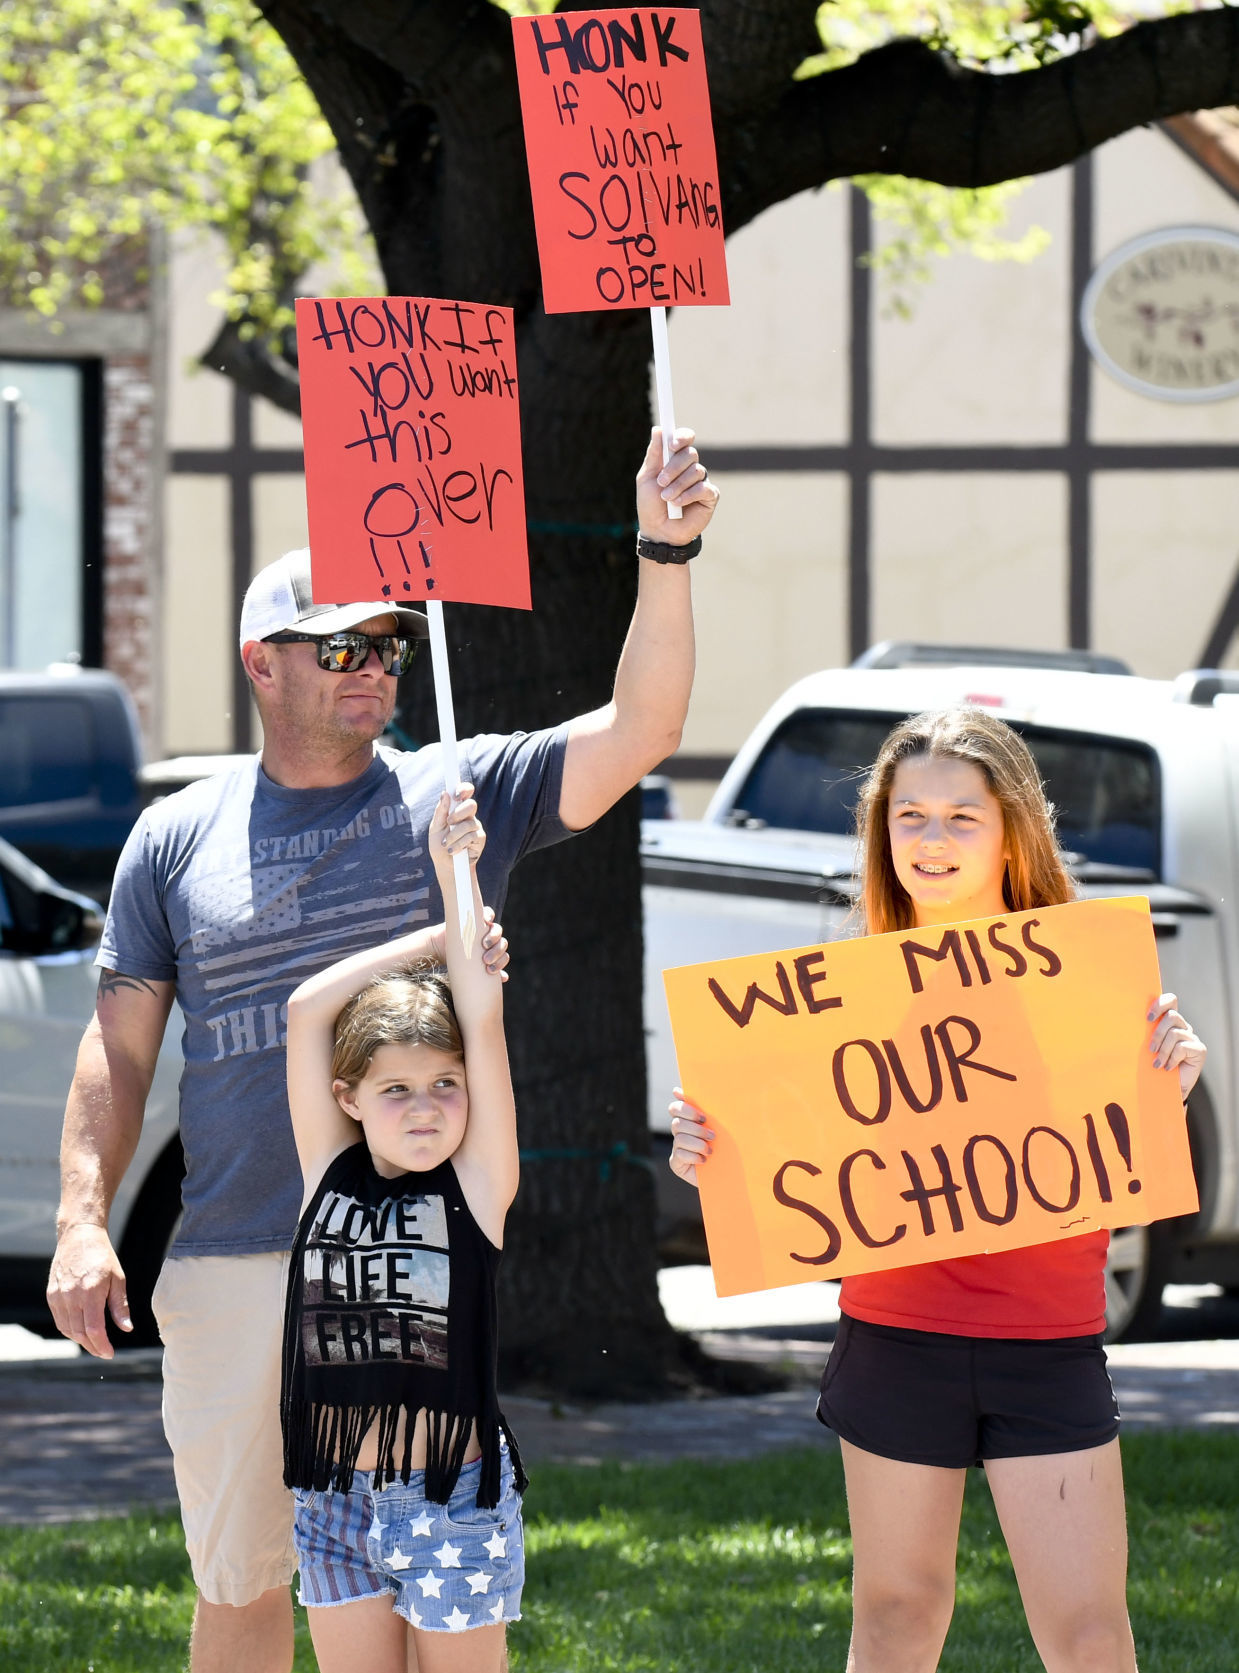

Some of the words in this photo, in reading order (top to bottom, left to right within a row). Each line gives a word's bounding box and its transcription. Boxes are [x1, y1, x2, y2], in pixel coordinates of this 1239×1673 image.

[530, 12, 690, 75] HONK
[596, 257, 706, 303] OPEN!
[312, 300, 442, 352] HONK
[344, 405, 451, 462] this
[369, 537, 435, 596] !!!
[707, 950, 843, 1029] WE
[899, 918, 1063, 994] MISS
[832, 1015, 1018, 1126] OUR
[317, 1197, 423, 1245] LOVE
[322, 1252, 413, 1302] LIFE
[315, 1311, 426, 1363] FREE
